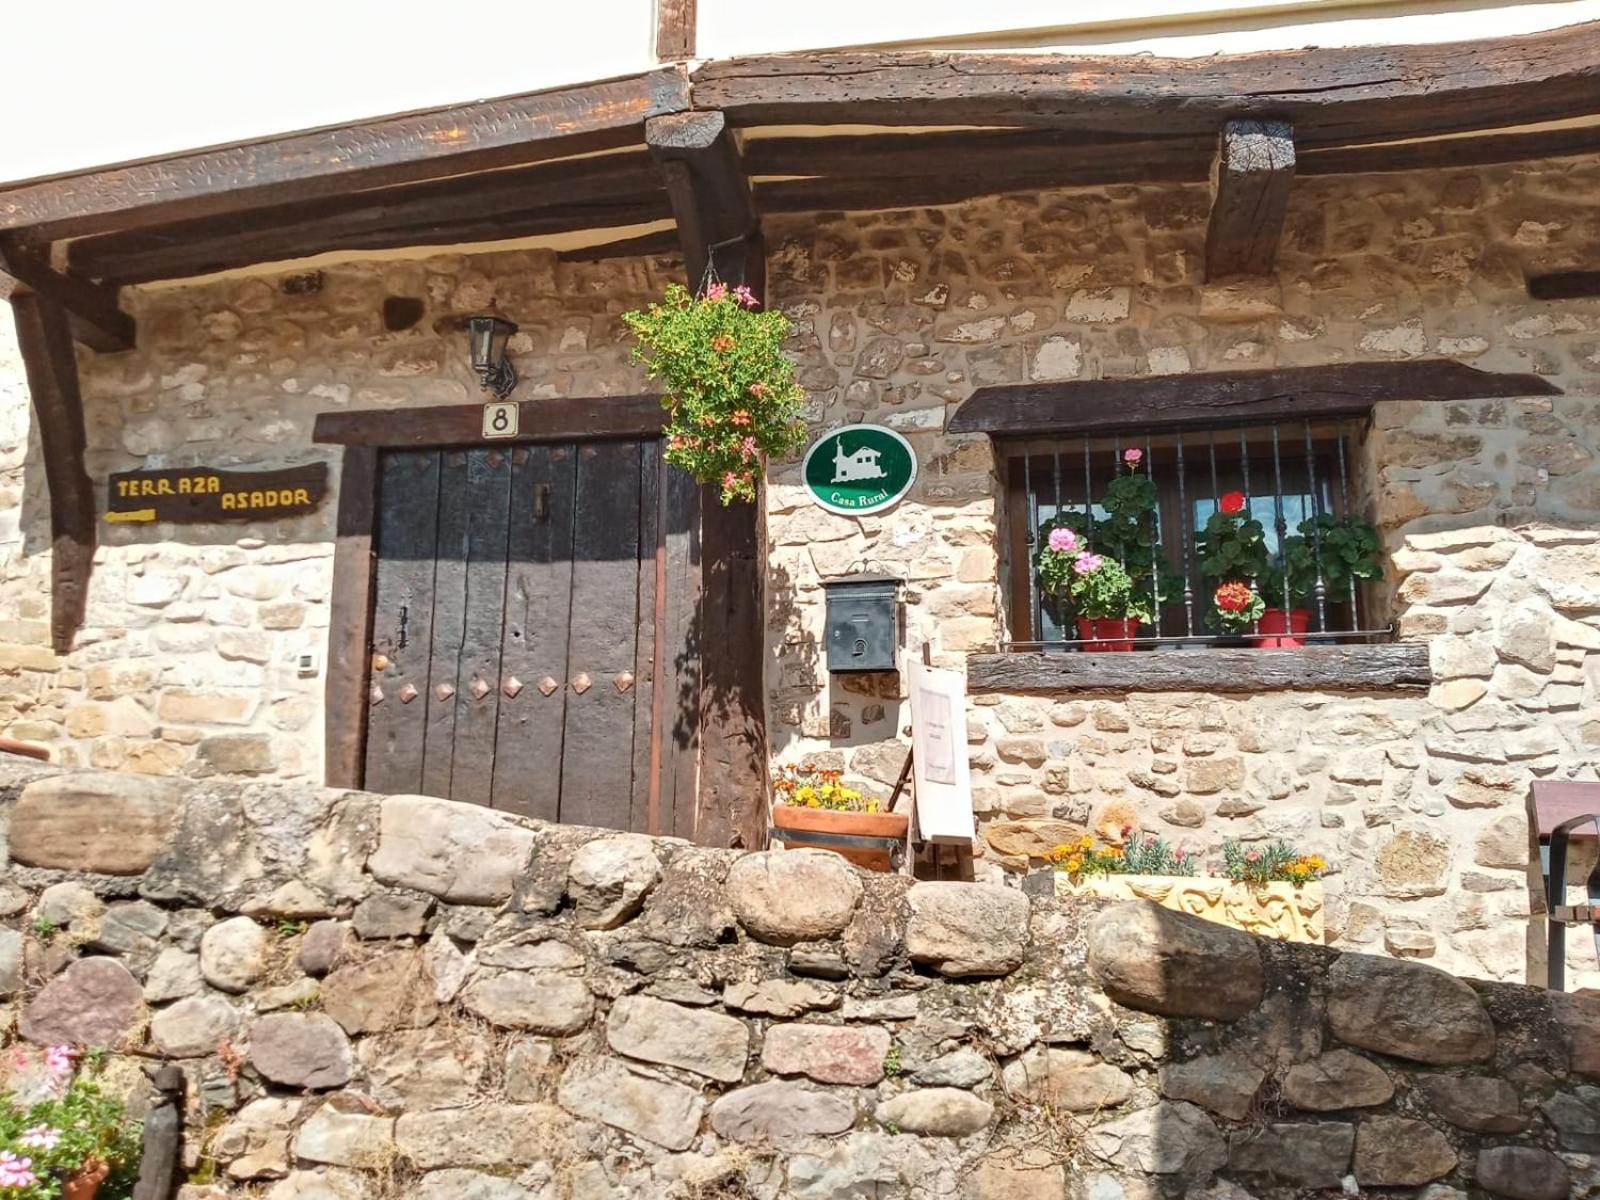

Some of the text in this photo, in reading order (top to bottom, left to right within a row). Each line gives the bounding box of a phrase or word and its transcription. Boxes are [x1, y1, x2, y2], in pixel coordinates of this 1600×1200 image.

[492, 408, 508, 431] 8
[118, 476, 220, 496] TERRAZA
[221, 489, 310, 509] ASADOR
[831, 488, 889, 507] Casa Rural
